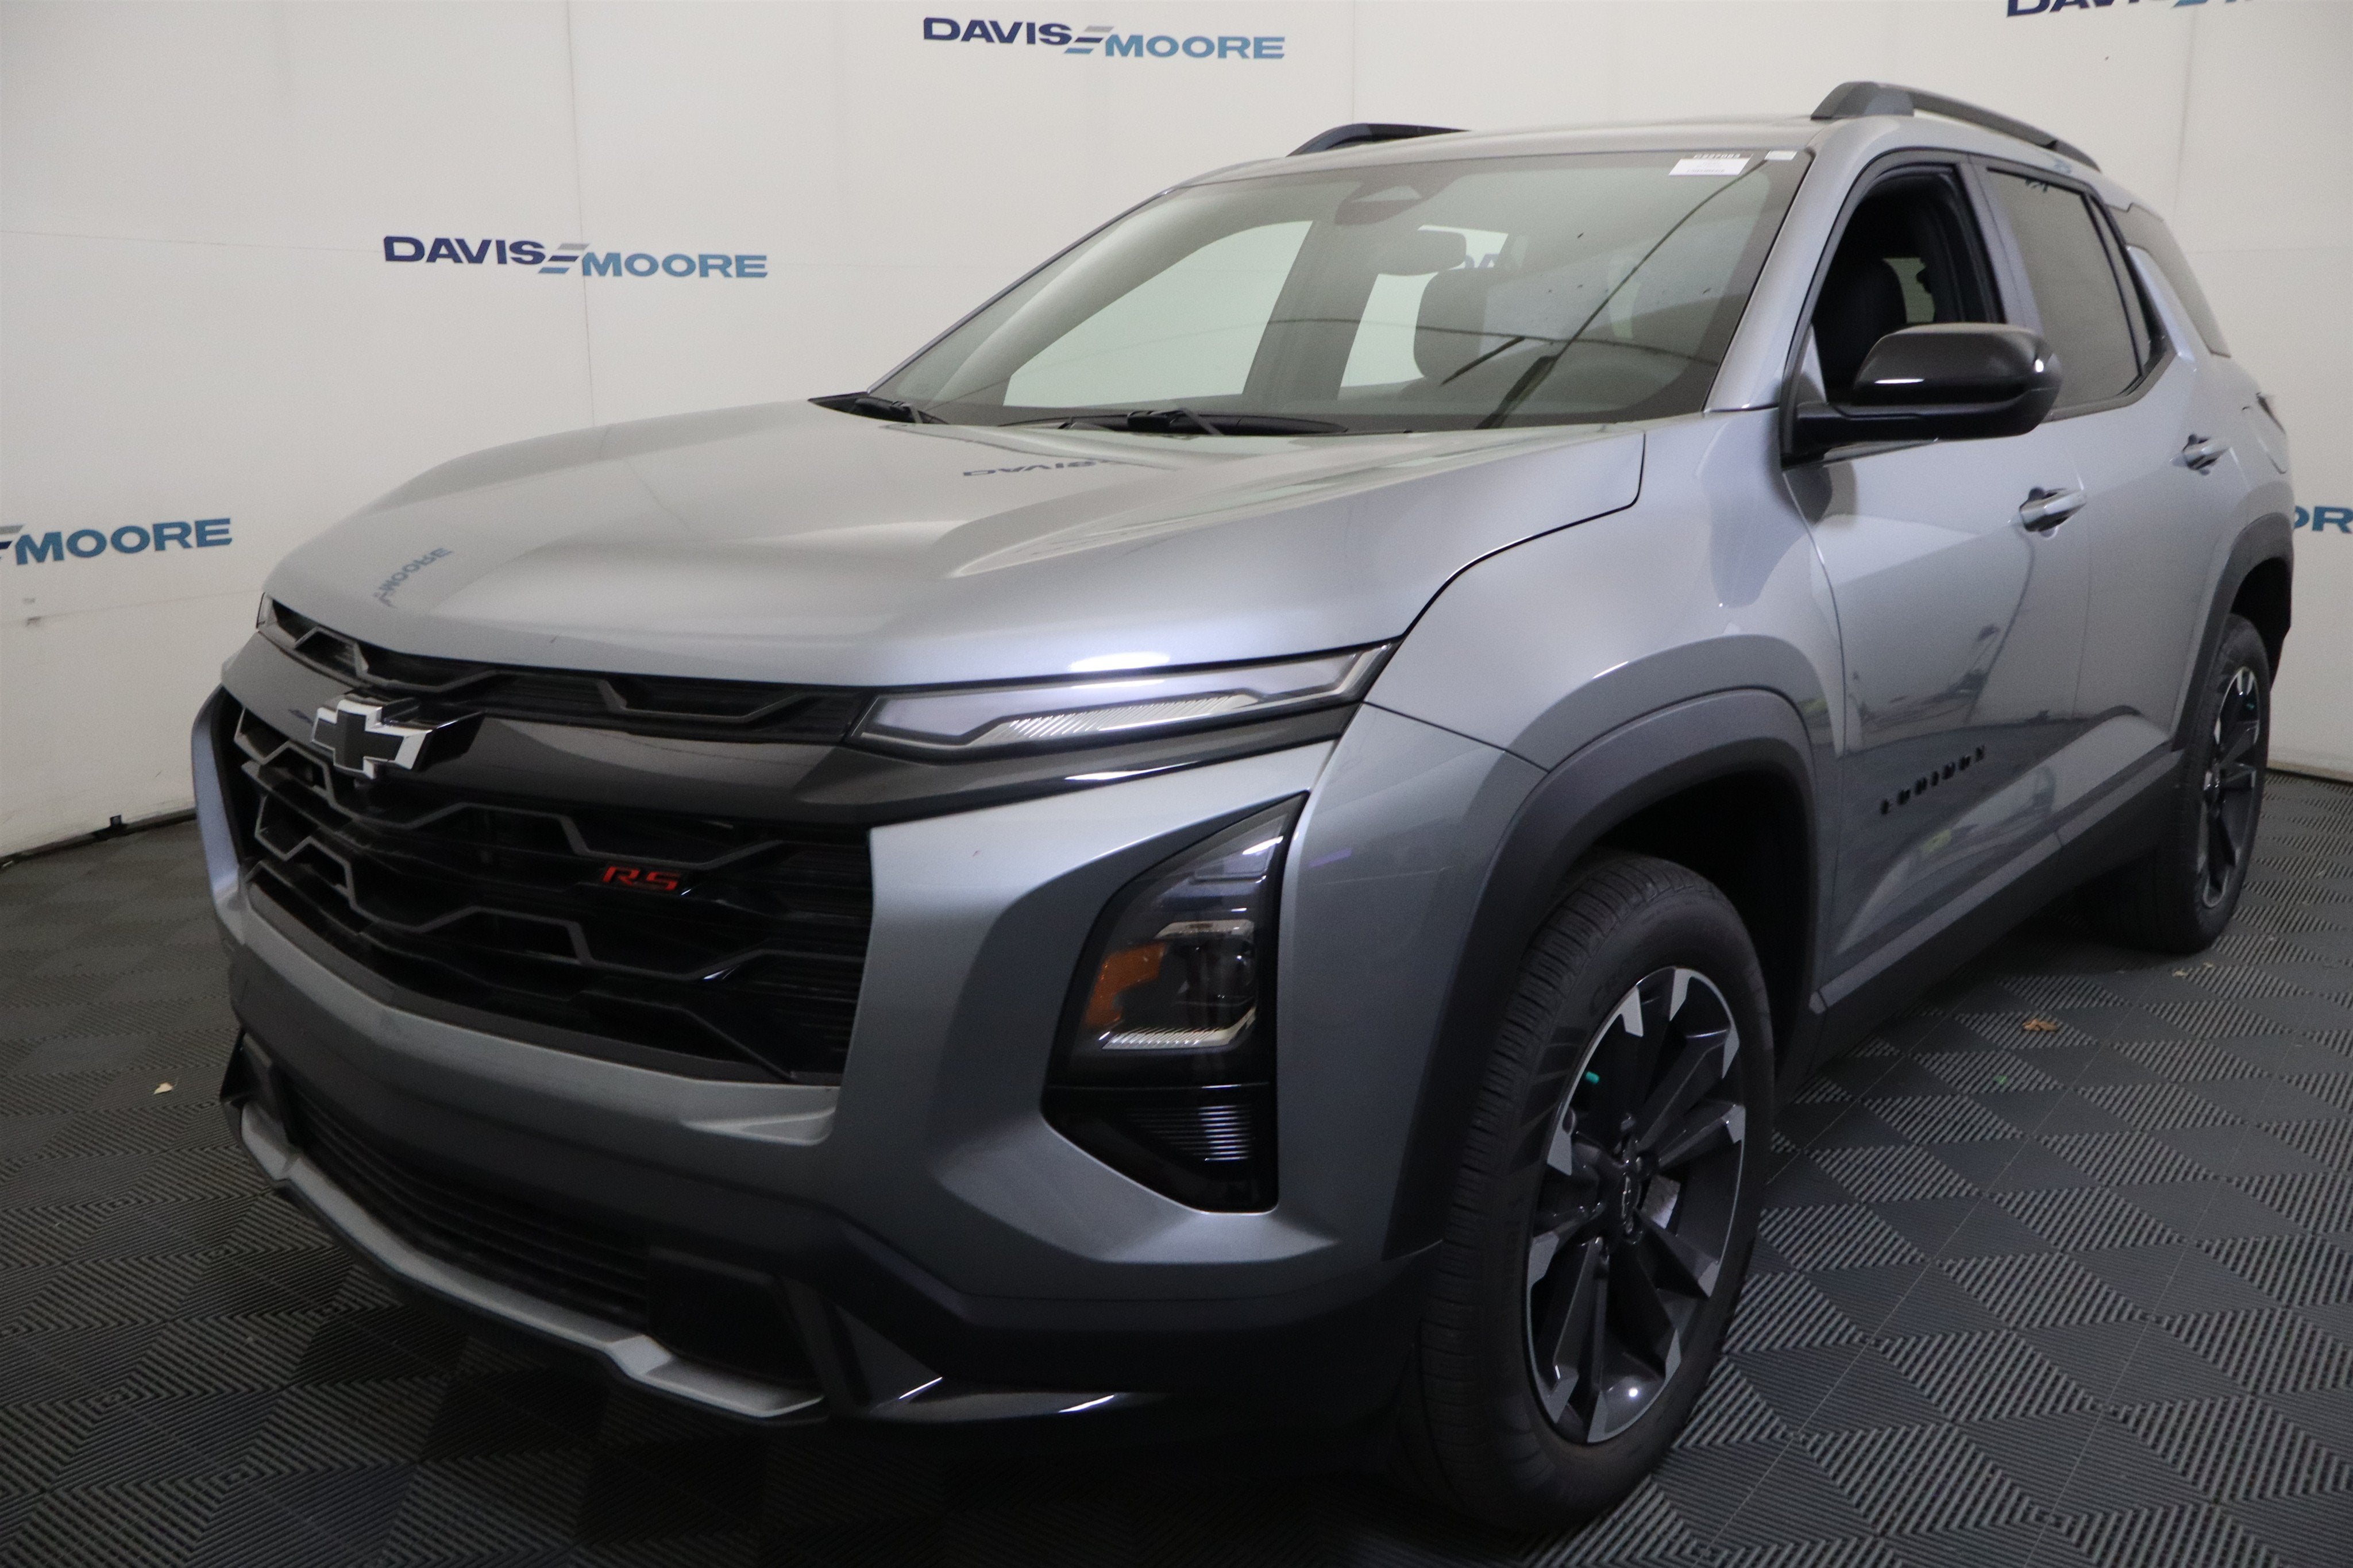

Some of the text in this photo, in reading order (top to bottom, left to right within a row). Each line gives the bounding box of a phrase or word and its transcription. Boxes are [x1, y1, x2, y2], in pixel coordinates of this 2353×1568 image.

[923, 17, 1285, 59] DAVIS MOORE
[384, 235, 769, 278] DAVIS MOORE
[15, 518, 232, 565] MOORE
[602, 866, 680, 890] RS
